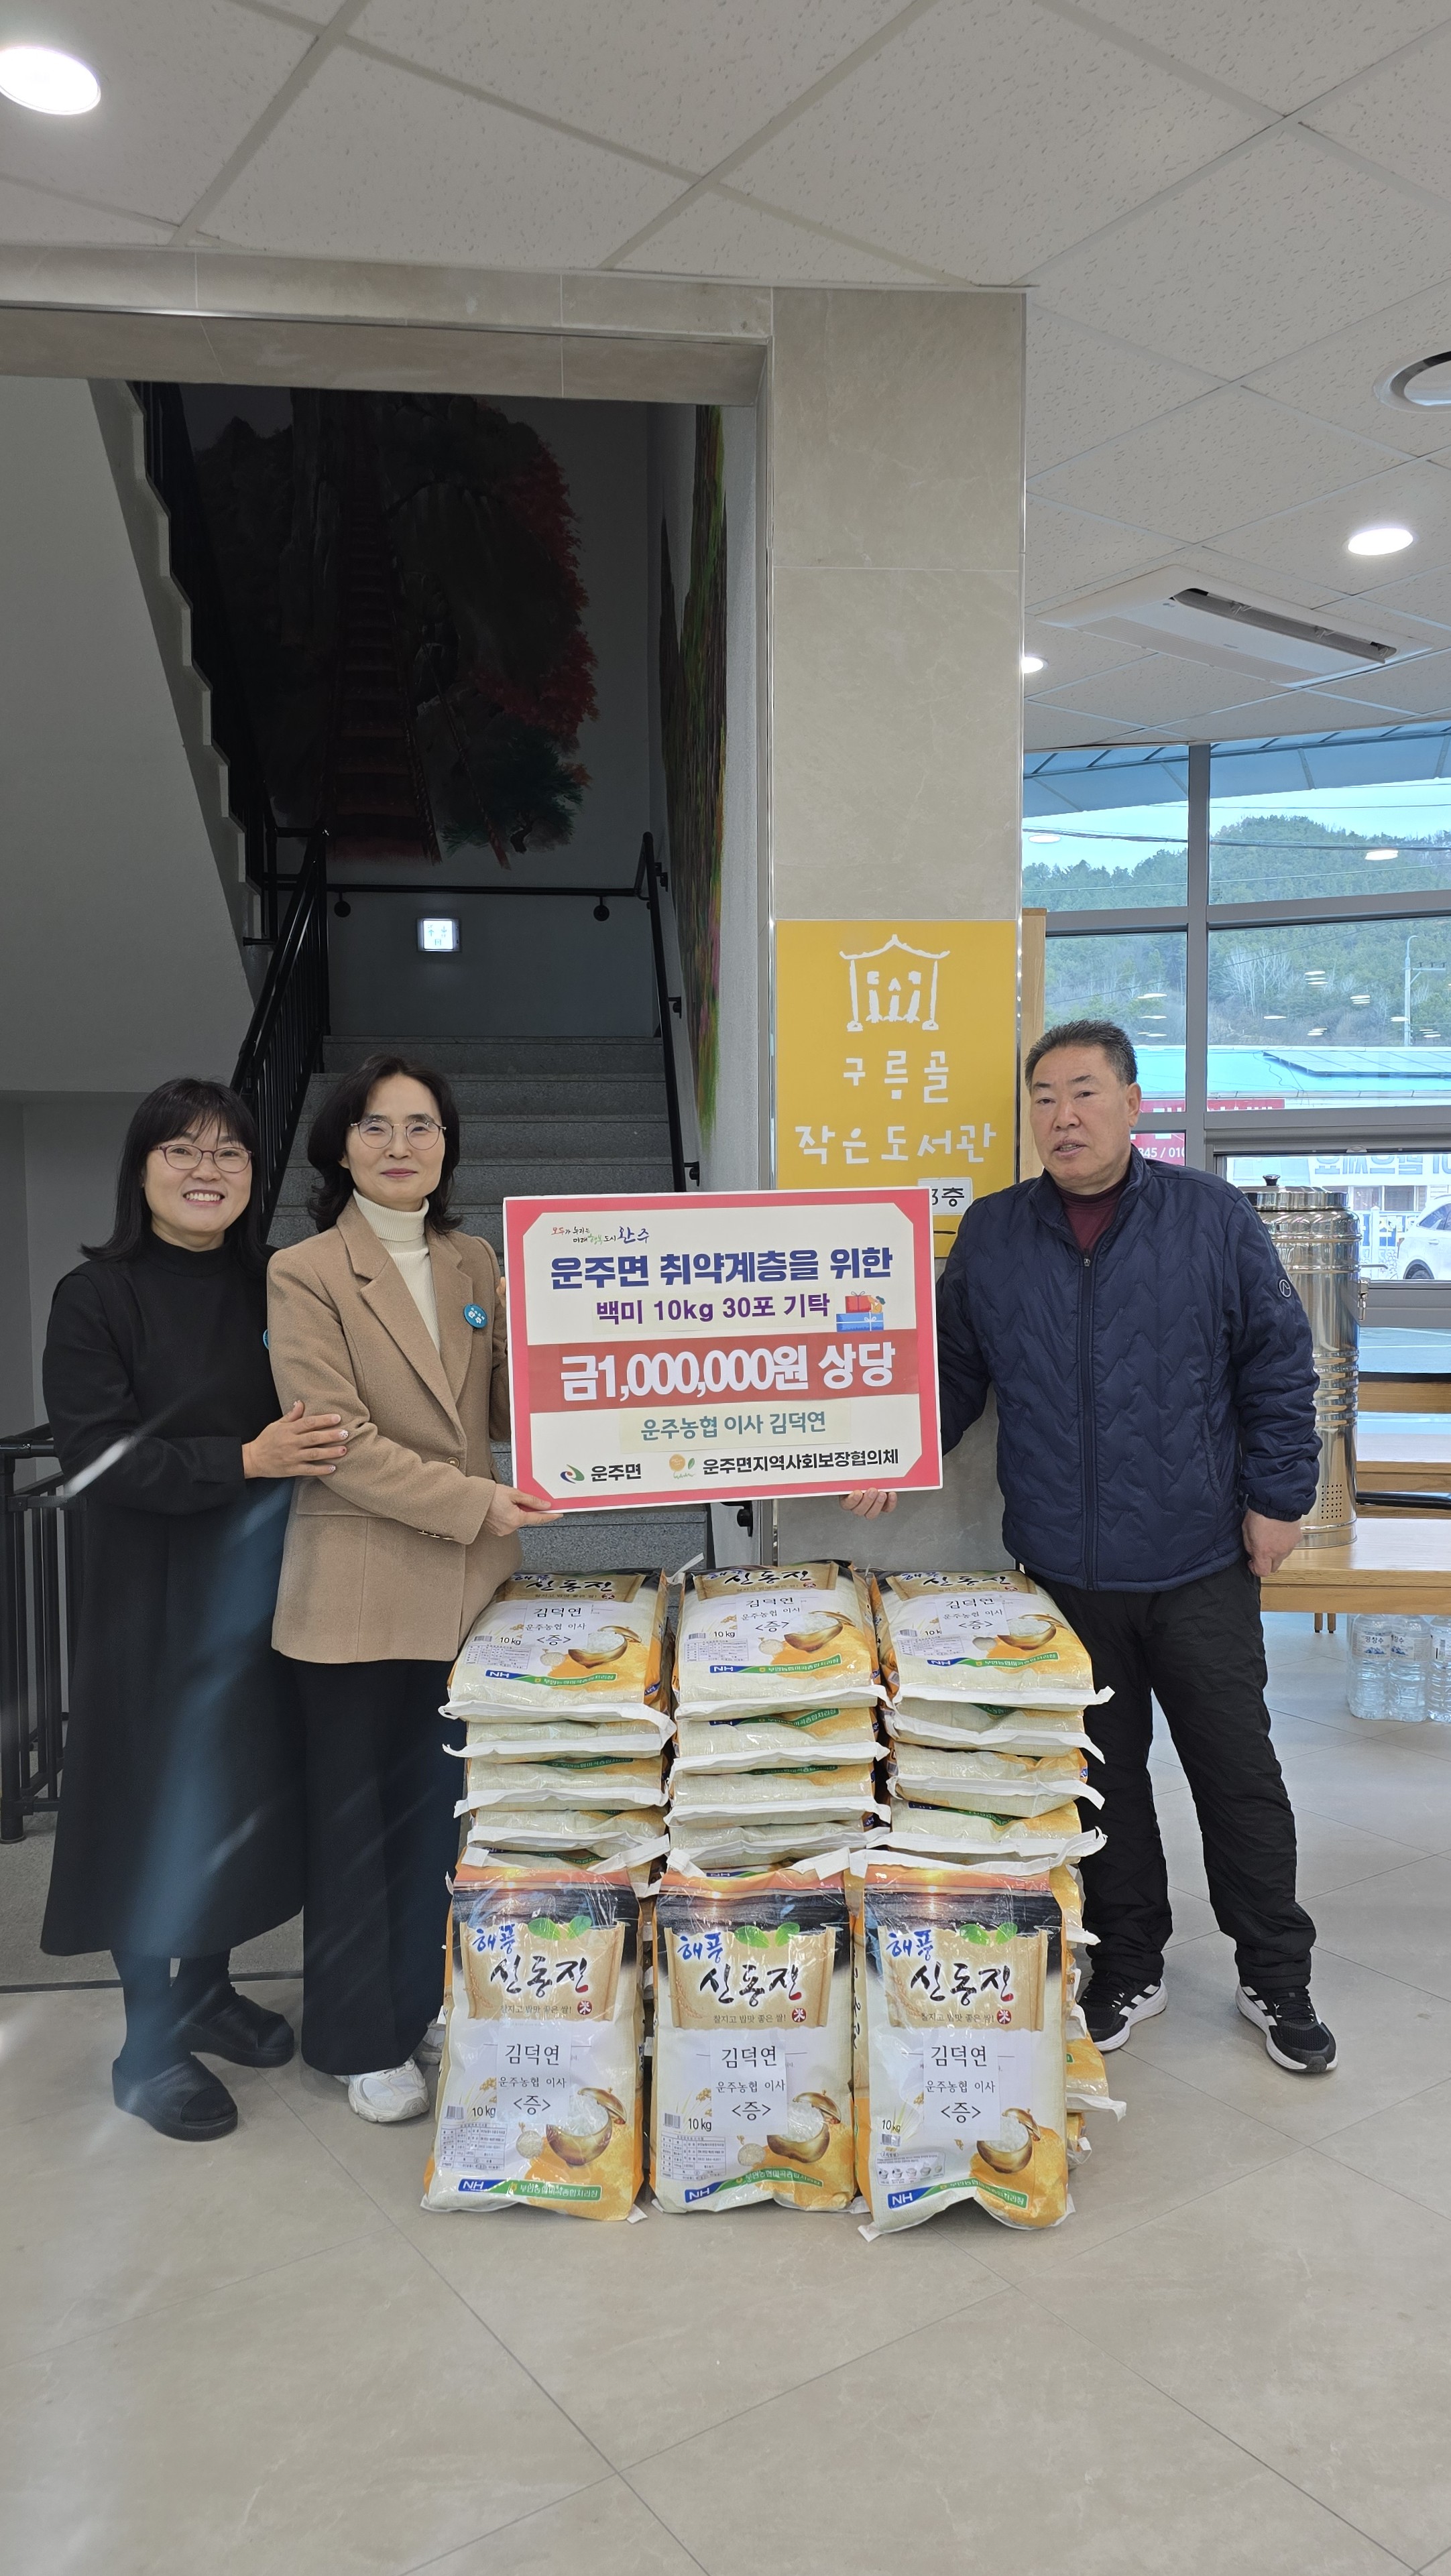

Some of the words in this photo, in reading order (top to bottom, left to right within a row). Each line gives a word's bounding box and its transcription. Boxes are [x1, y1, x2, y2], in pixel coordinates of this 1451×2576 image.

[844, 1050, 949, 1103] 구름골
[931, 1187, 965, 1207] 3층
[551, 1227, 571, 1235] 모두가
[572, 1226, 590, 1235] 누리는
[550, 1255, 650, 1290] 운주면
[660, 1249, 819, 1286] 취약계층을
[830, 1247, 893, 1278] 위한
[597, 1299, 643, 1326] 백미
[653, 1298, 713, 1323] 10kg
[723, 1295, 776, 1319] 30포
[783, 1293, 831, 1318] 기탁
[561, 1345, 809, 1402] 금1,000,000원
[819, 1341, 896, 1389] 상당
[640, 1416, 718, 1440] 운주농협
[723, 1413, 763, 1436] 이사
[770, 1411, 826, 1435] 김덕연
[590, 1464, 642, 1483] 운주면
[703, 1449, 899, 1475] 운주면지역사회보장협의체
[724, 1570, 813, 1586] 신동진
[526, 1579, 613, 1593] 신동진
[746, 1597, 794, 1607] 김덕연
[946, 1598, 994, 1609] 김덕연
[534, 1607, 582, 1618] 김덕연
[741, 1610, 778, 1621] 운주농협
[526, 1623, 563, 1631] 운주농협
[568, 1622, 587, 1631] 이사
[511, 1638, 522, 1646] kg
[489, 1954, 589, 1998] 신동진
[699, 1963, 803, 2008] 신동진
[910, 1961, 1014, 2006] 신동진
[713, 2015, 737, 2024] 찰지고
[739, 2014, 756, 2024] 밥맛
[758, 2014, 773, 2023] 좋은
[776, 2013, 787, 2023] 쌀!
[505, 2044, 560, 2067] 김덕연
[721, 2045, 778, 2069] 김덕연
[931, 2045, 988, 2067] 김덕연
[498, 2076, 540, 2089] 운주농협
[546, 2076, 567, 2089] 이사
[715, 2081, 758, 2093] 운주농협
[764, 2080, 786, 2092] 이사
[925, 2080, 968, 2093] 운주농협
[975, 2080, 996, 2093] 이사
[472, 2106, 483, 2118] 10
[485, 2106, 496, 2119] kg
[688, 2118, 699, 2131] 10
[701, 2118, 712, 2132] kg
[882, 2120, 892, 2130] 10
[892, 2125, 901, 2133] kg
[463, 2181, 484, 2189] NH
[689, 2188, 710, 2200] NH
[892, 2193, 913, 2205] NH
